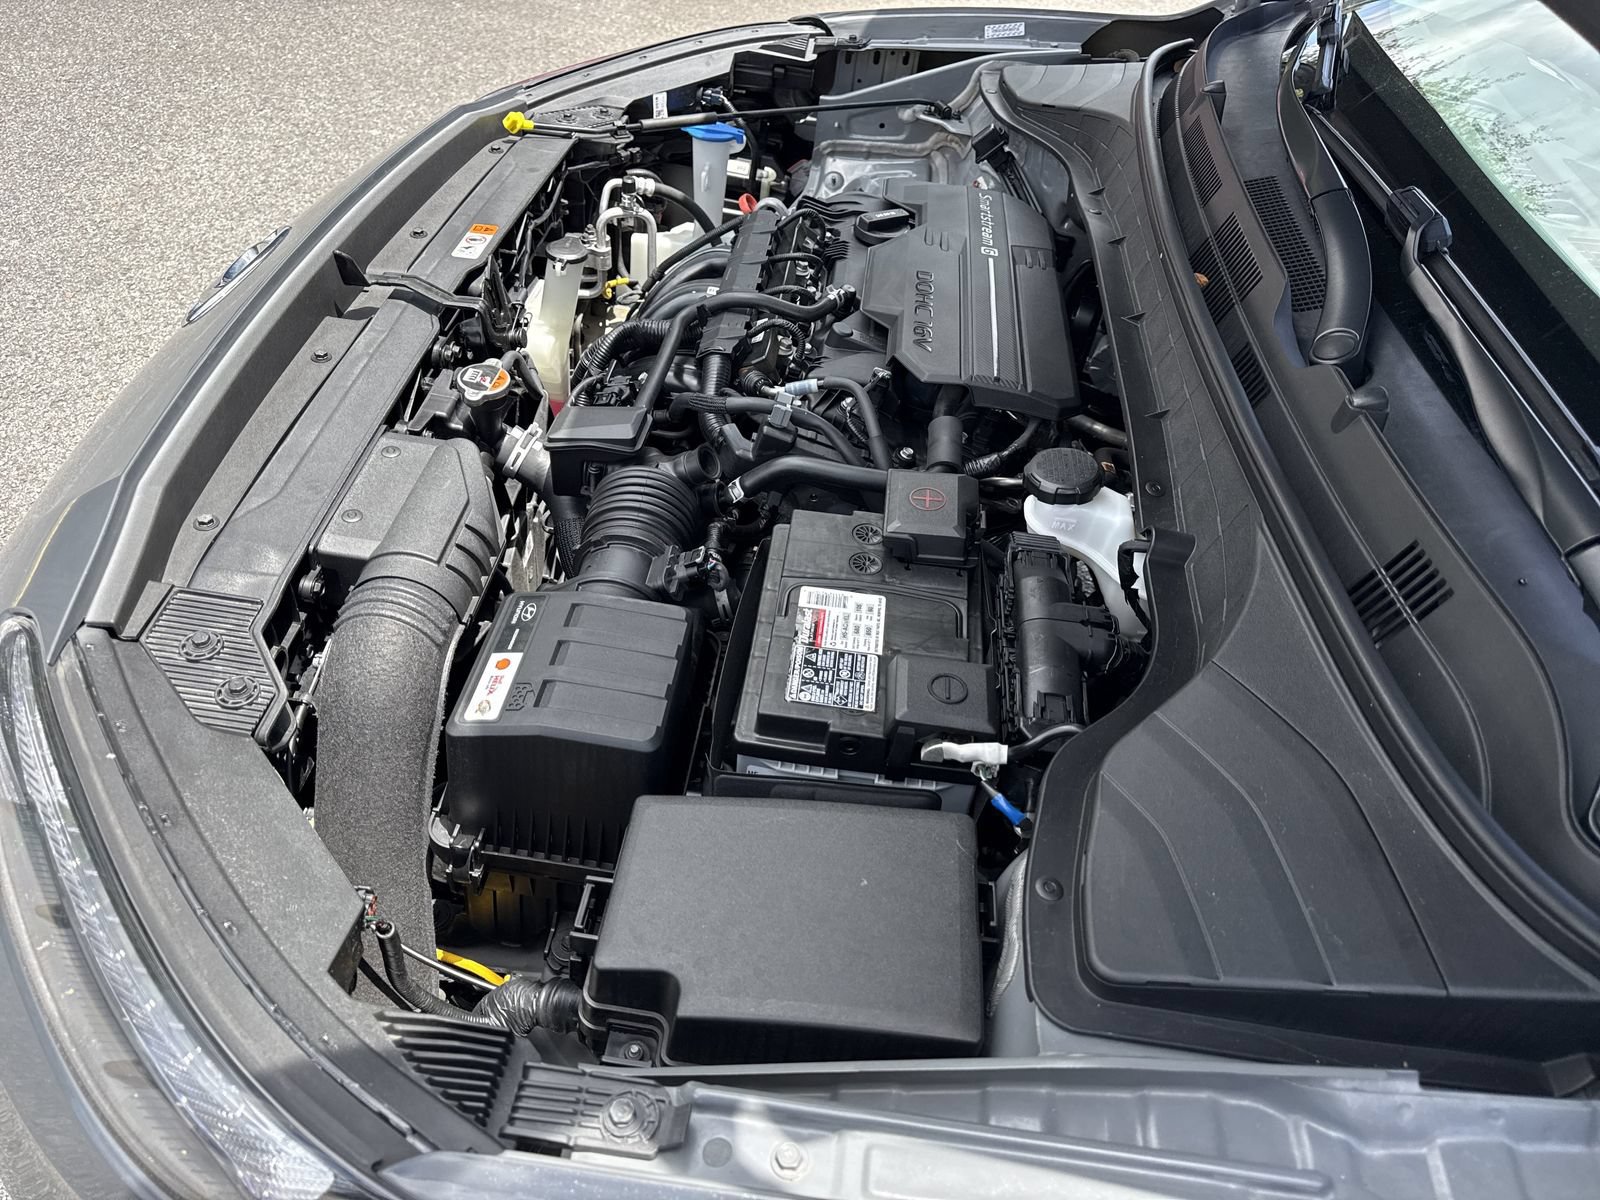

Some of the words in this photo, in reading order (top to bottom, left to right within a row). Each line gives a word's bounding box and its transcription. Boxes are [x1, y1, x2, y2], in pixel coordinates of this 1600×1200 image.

[978, 193, 994, 245] Smartstream
[981, 246, 999, 257] G
[914, 270, 935, 318] DOHC
[912, 321, 934, 353] 16V
[1051, 521, 1076, 531] MAX
[511, 600, 525, 625] HYUNDAI
[800, 608, 813, 645] Duralast
[488, 675, 501, 696] HELIX
